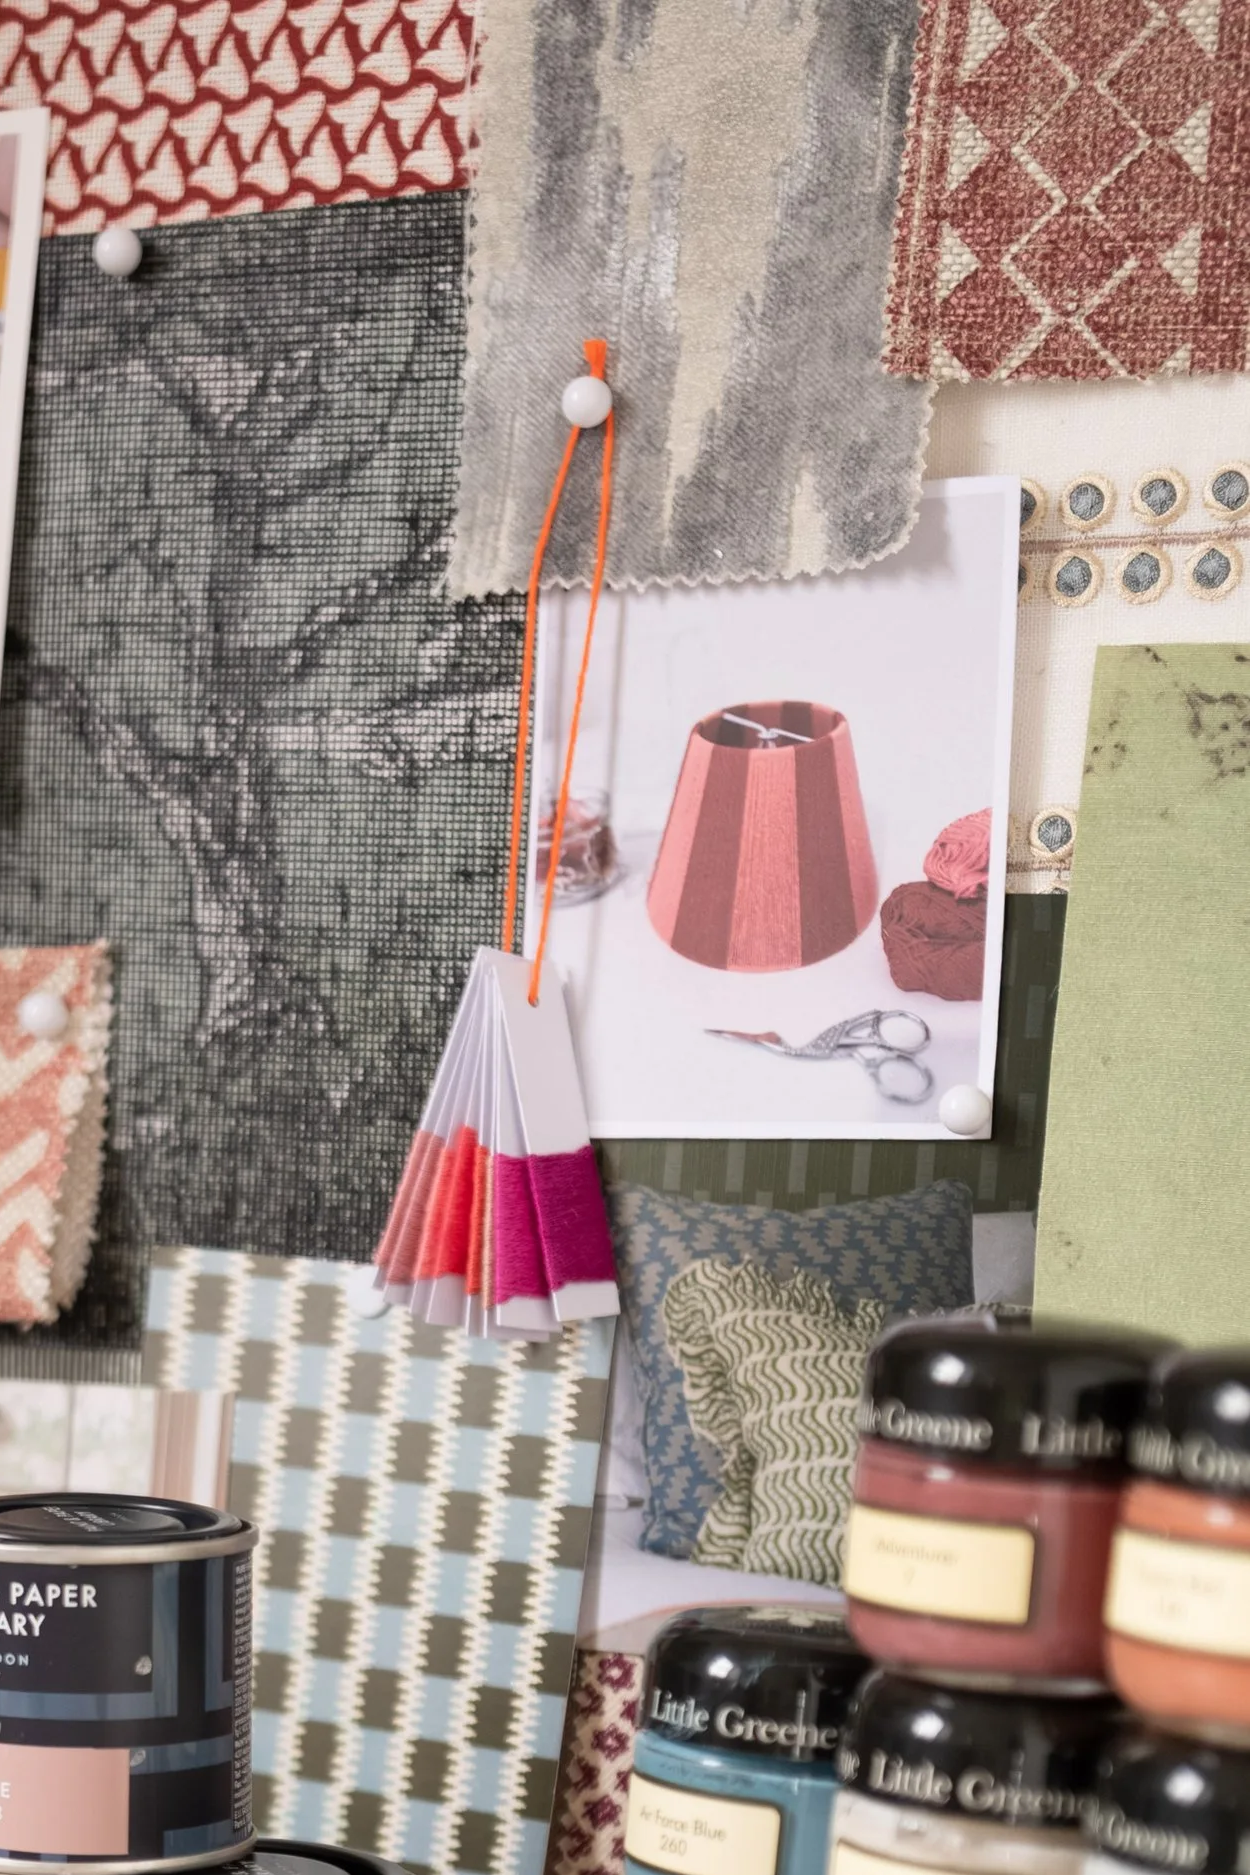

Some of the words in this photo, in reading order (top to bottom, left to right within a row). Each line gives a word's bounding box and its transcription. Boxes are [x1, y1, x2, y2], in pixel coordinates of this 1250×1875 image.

[885, 1398, 993, 1451] Greene
[1021, 1410, 1122, 1457] Little
[9, 1581, 98, 1608] PAPER
[651, 1689, 710, 1731] Little
[715, 1703, 838, 1749] Greene
[868, 1750, 953, 1805] Little
[654, 1810, 689, 1833] Force
[694, 1819, 727, 1842] Blue
[660, 1835, 688, 1857] 260
